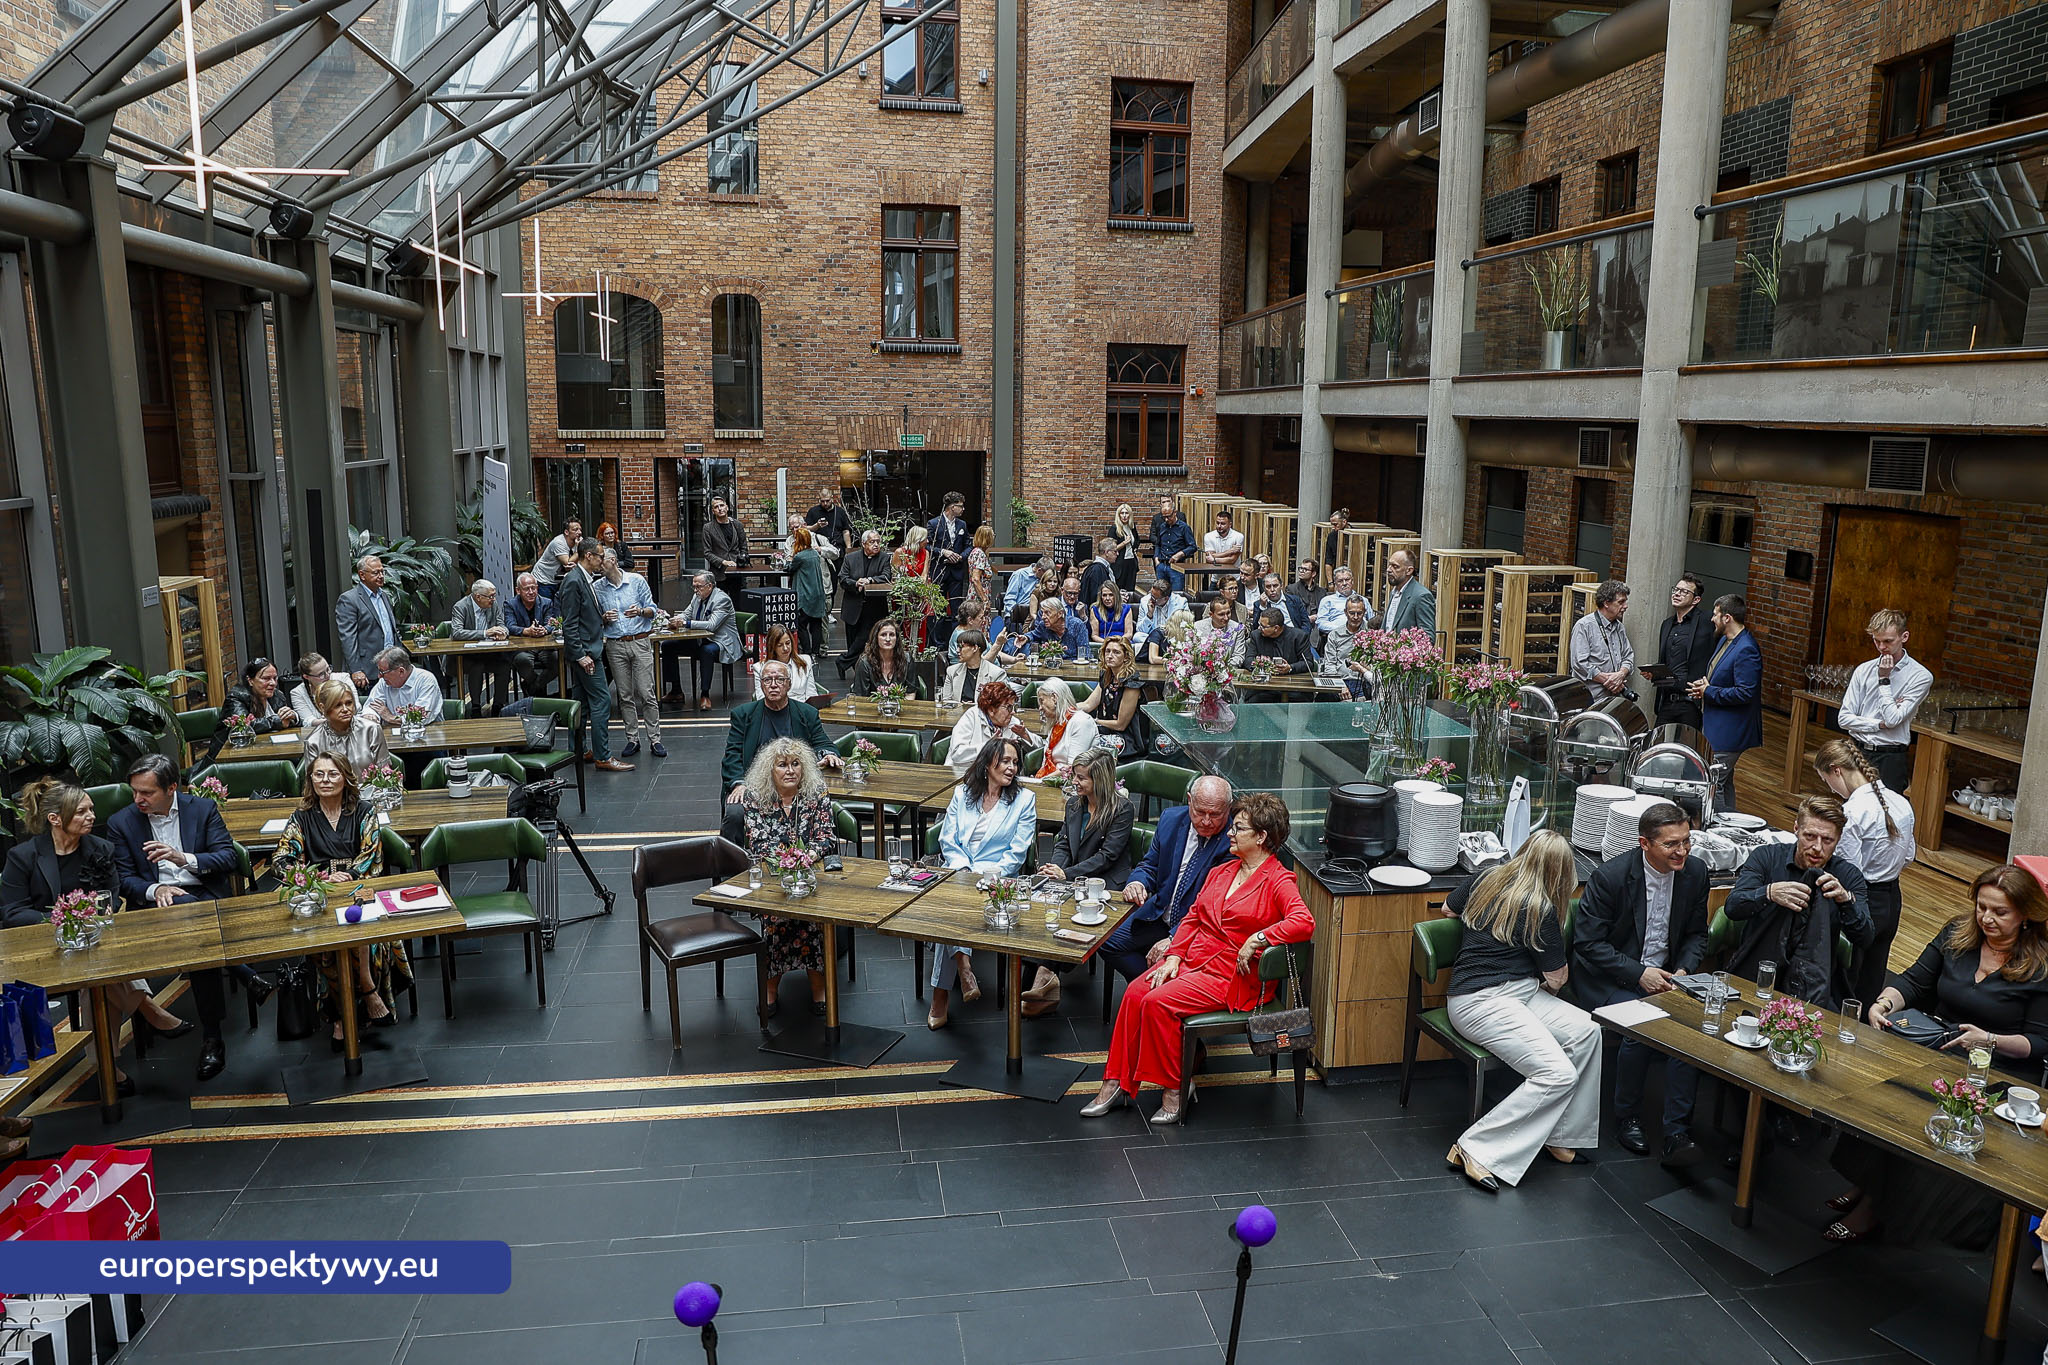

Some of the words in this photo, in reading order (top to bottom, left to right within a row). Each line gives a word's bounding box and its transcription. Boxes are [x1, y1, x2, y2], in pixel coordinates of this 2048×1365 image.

[765, 594, 796, 603] MIKRO
[765, 603, 796, 613] MAKRO
[765, 613, 796, 622] METRO
